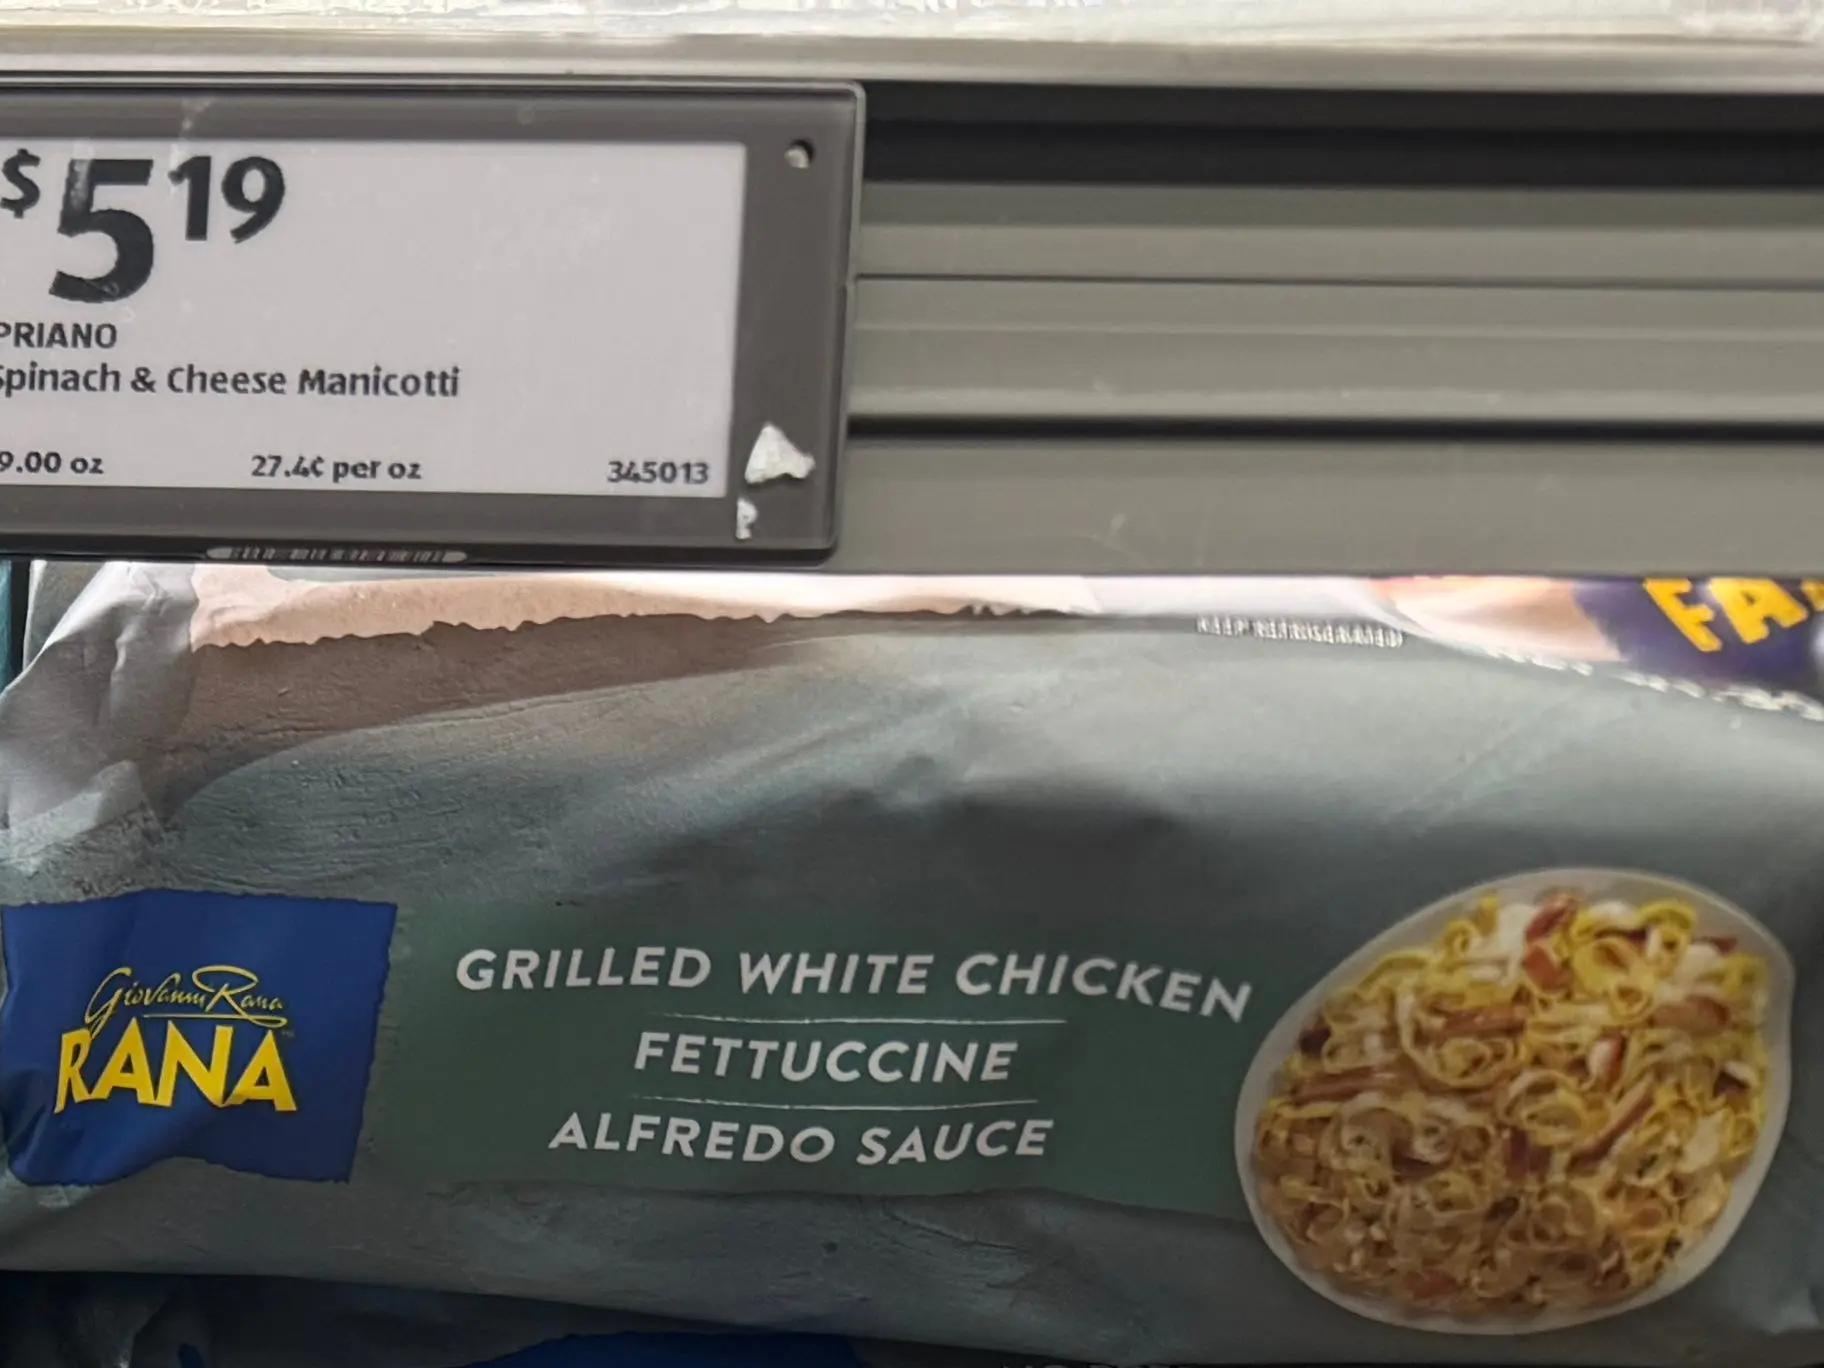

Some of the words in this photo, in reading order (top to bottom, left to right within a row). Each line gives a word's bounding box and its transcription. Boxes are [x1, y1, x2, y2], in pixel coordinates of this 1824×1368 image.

[130, 366, 156, 393] &
[167, 364, 287, 396] Cheese
[297, 366, 460, 398] Manicotti
[69, 455, 104, 476] oz
[333, 458, 379, 486] per
[386, 460, 422, 481] oz
[607, 460, 709, 486] 345013
[455, 946, 712, 992] GRILLED
[738, 951, 935, 996] WHITE
[954, 952, 1253, 1023] CHICKEN
[54, 1015, 298, 1114] RANA
[635, 1030, 1019, 1083] FETTUCCINE
[549, 1112, 837, 1165] ALFREDO
[857, 1118, 1054, 1168] SAUCE
